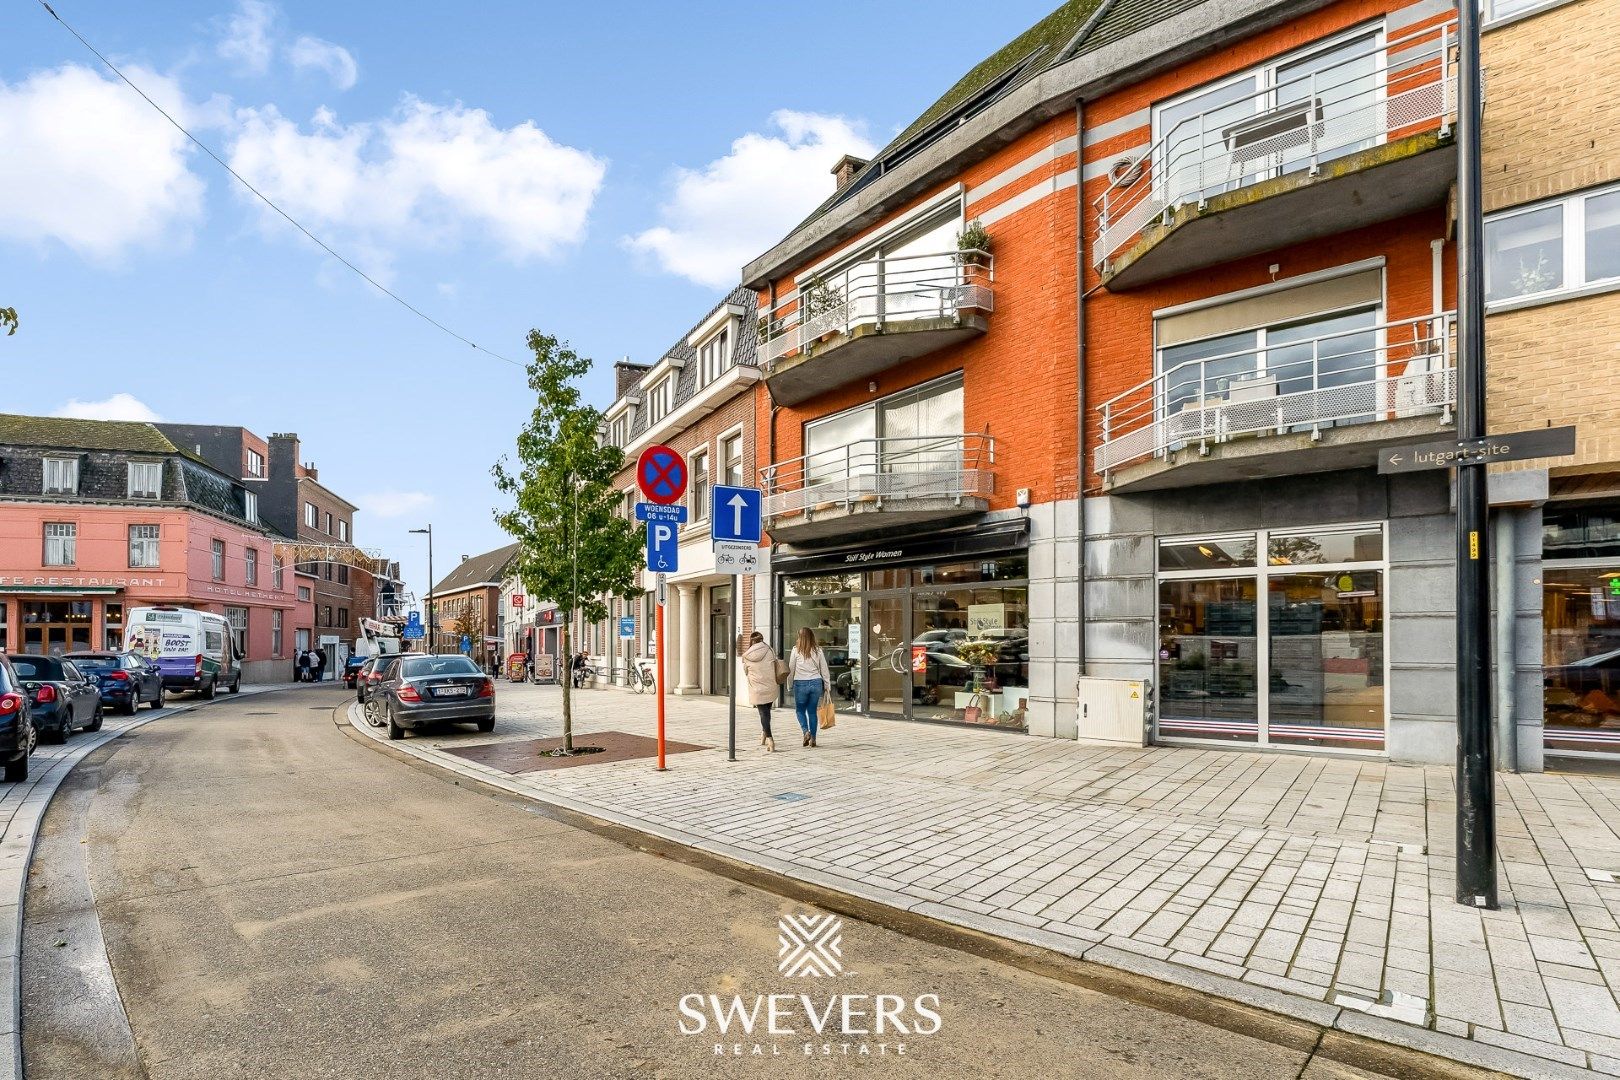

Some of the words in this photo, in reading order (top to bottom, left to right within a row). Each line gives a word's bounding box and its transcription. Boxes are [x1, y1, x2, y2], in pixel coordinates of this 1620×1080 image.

[1414, 442, 1510, 466] lutgart-site
[644, 505, 680, 514] WOENSDAG
[654, 525, 672, 552] P
[875, 550, 903, 559] Women
[33, 577, 166, 587] RESTAURANT
[207, 586, 242, 596] HOTEL
[410, 613, 417, 622] P
[165, 639, 191, 647] BOOST
